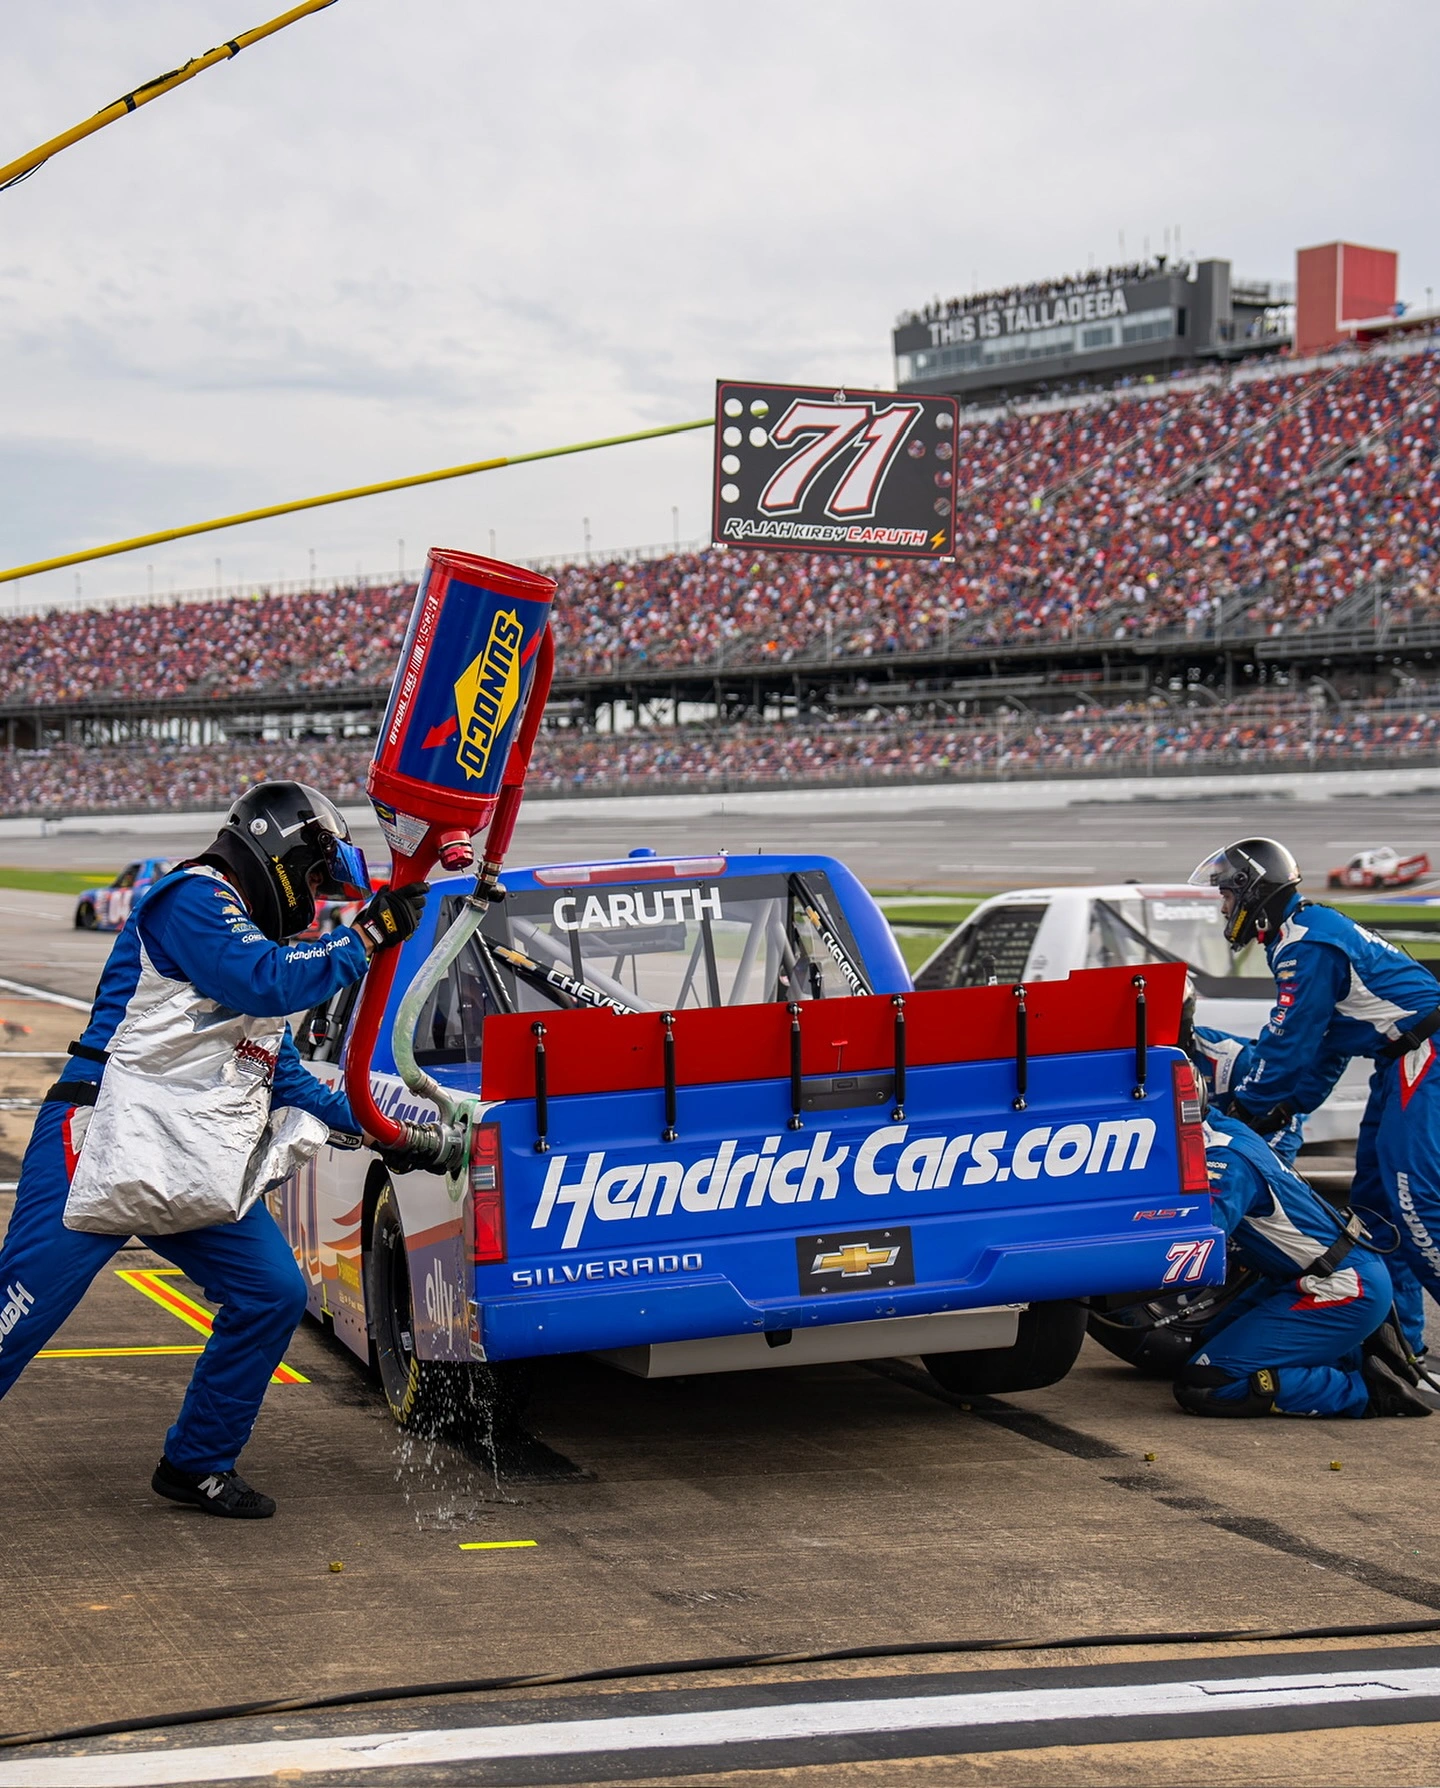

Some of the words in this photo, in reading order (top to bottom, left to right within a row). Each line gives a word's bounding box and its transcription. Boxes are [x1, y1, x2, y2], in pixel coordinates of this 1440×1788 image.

[928, 315, 976, 347] THIS
[979, 310, 1001, 336] IS
[1002, 289, 1129, 333] TALLADEGA
[757, 398, 924, 521] 71
[724, 518, 794, 539] RAJAH
[793, 522, 847, 541] KIRBY
[846, 526, 928, 546] CARUTH
[389, 700, 408, 745] OFFICIAL
[402, 672, 417, 698] FUEL
[459, 615, 520, 774] SUNOCO
[275, 863, 297, 907] GAINBRIDGE
[553, 887, 724, 931] CARUTH
[531, 1117, 1158, 1249] HendrickCars.com
[1132, 1206, 1199, 1222] RST
[511, 1252, 703, 1289] SILVERADO
[1163, 1239, 1215, 1283] 71
[426, 1257, 454, 1350] ally
